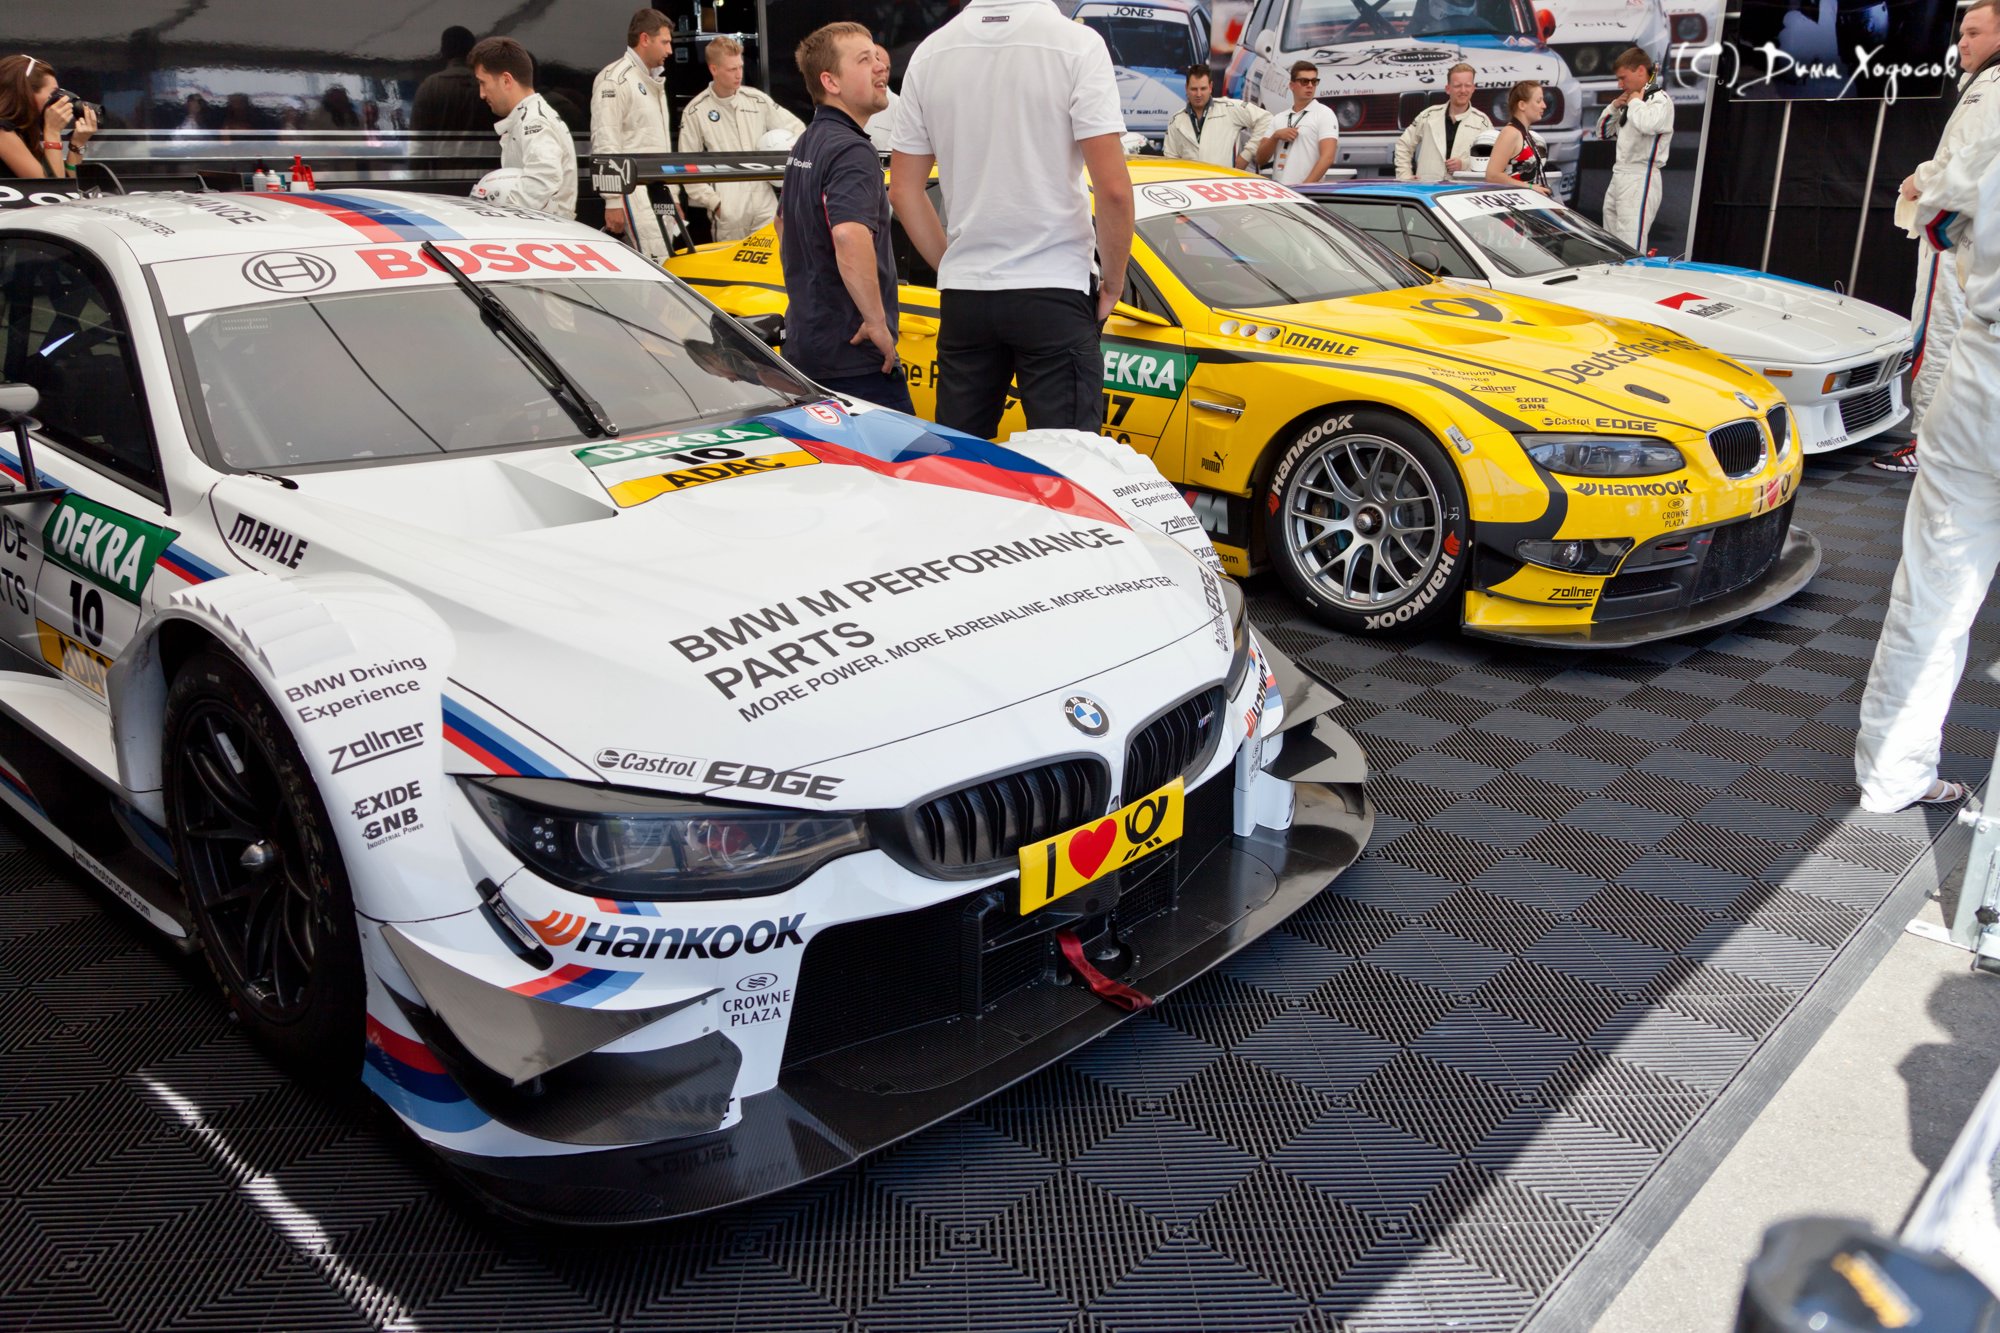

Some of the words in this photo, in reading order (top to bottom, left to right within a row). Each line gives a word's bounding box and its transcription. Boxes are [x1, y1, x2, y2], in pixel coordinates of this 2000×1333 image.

[1113, 6, 1154, 18] JONES
[592, 174, 622, 191] PUMA
[1187, 181, 1300, 203] BOSCH
[1464, 192, 1533, 210] PIQUET
[733, 249, 773, 265] EDGE
[748, 237, 775, 249] Castrol
[356, 243, 622, 281] BOSCH
[1285, 332, 1360, 357] MAHLE
[1103, 350, 1177, 392] EKRA
[1457, 369, 1497, 377] Driving
[1541, 340, 1670, 385] Deutsche
[1554, 417, 1591, 426] Castrol
[1595, 418, 1659, 433] EDGE
[585, 427, 771, 461] DEKRA
[655, 447, 746, 466] 10
[661, 456, 787, 489] ADAC
[1200, 457, 1221, 474] PUMA
[1112, 484, 1141, 498] BMW
[1142, 480, 1174, 491] Driving
[1131, 491, 1183, 508] Experience
[1662, 509, 1689, 520] CROWNE
[1664, 518, 1685, 528] PLAZA
[0, 515, 28, 561] CE
[52, 504, 146, 592] DEKRA
[228, 512, 309, 570] MAHLE
[0, 567, 29, 615] TS
[668, 602, 800, 663] BMW
[796, 588, 852, 617] M
[842, 527, 1125, 604] PERFORMANCE
[1198, 565, 1223, 616] EDGE
[69, 579, 105, 648] 10
[703, 621, 876, 701] PARTS
[738, 684, 810, 723] MORE
[805, 653, 889, 692] POWER.
[885, 632, 946, 660] MORE
[944, 601, 1054, 641] ADRENALINE.
[1049, 588, 1100, 609] MORE
[1094, 576, 1180, 598] CHARACTER.
[284, 673, 346, 703] BMW
[349, 657, 427, 683] Driving
[297, 680, 421, 724] Experience
[620, 752, 697, 778] Castrol
[703, 760, 845, 801] EDGE
[352, 780, 422, 820] EXIDE
[362, 807, 419, 840] GNB
[1046, 842, 1057, 900] I
[722, 989, 792, 1013] CROWNE
[730, 1007, 782, 1027] PLAZA
